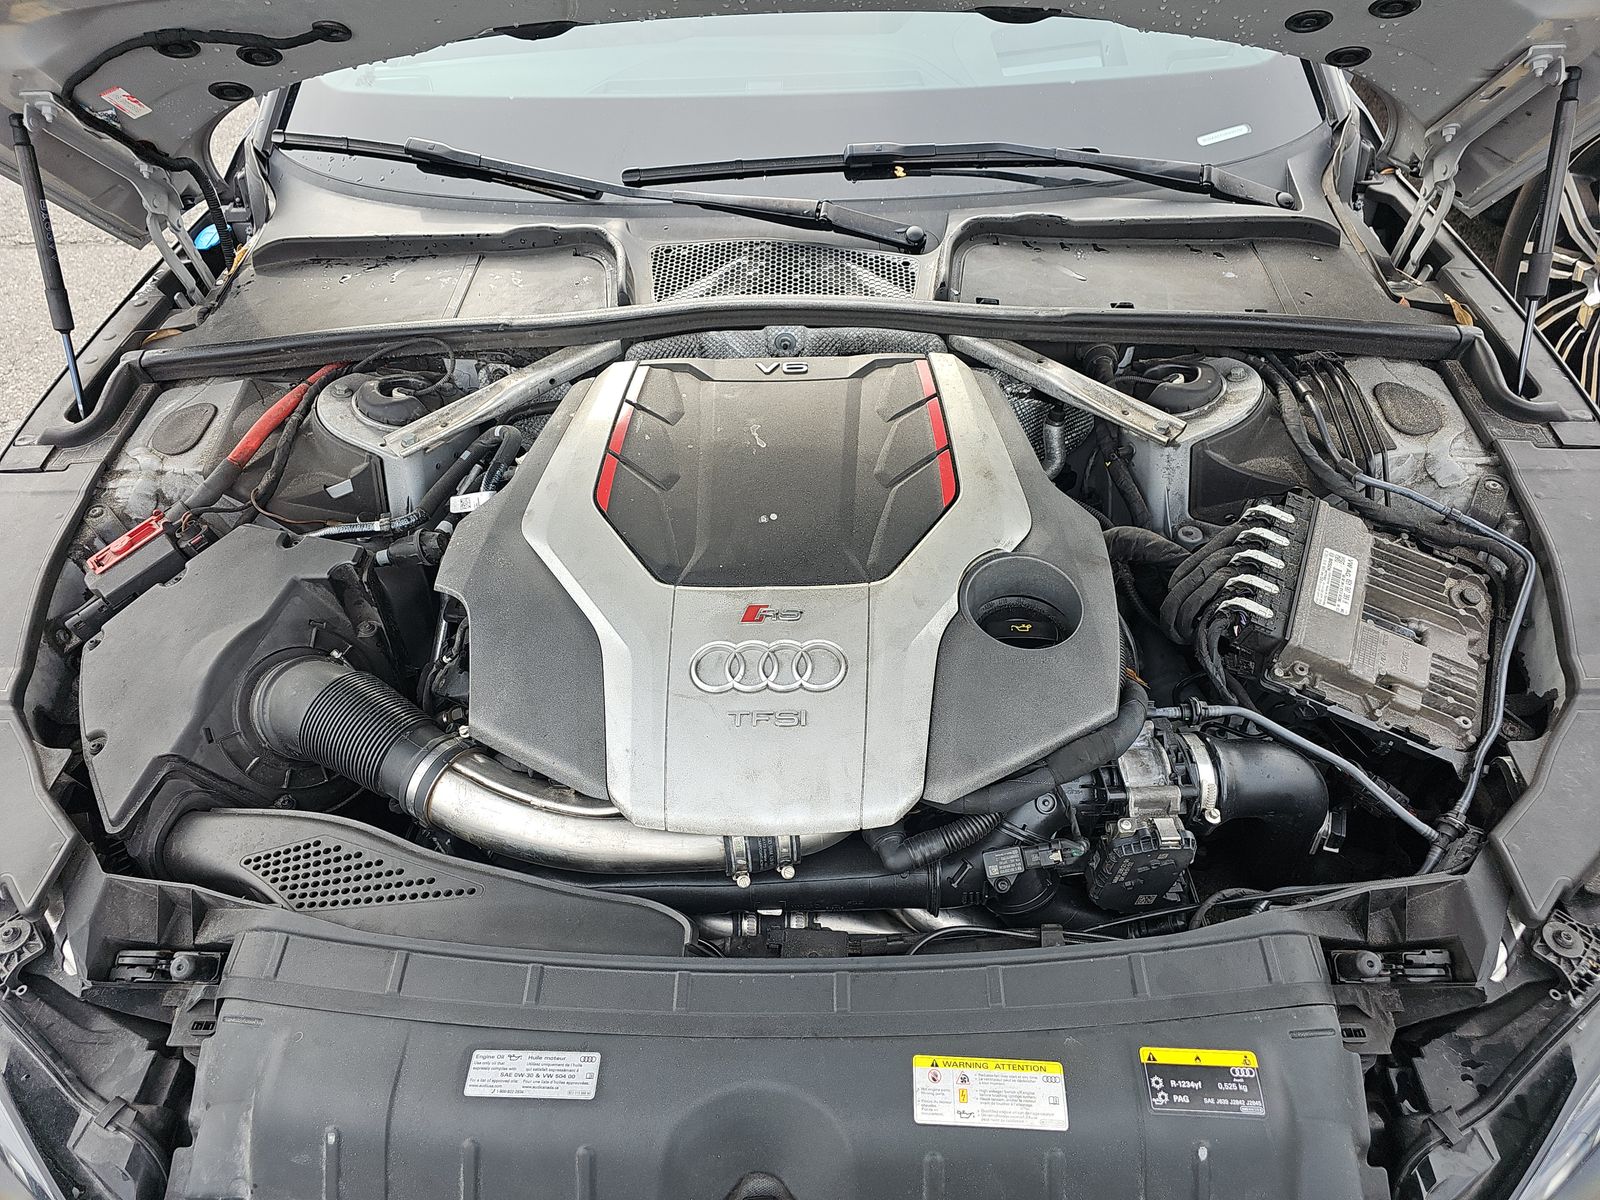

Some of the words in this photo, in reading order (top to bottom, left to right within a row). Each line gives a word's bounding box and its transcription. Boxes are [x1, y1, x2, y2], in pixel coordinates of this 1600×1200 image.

[754, 362, 808, 375] V6
[754, 606, 804, 623] RS
[728, 710, 808, 728] TFSI
[942, 1060, 989, 1070] WARNING
[994, 1063, 1047, 1072] ATTENTION
[1170, 1080, 1202, 1090] R-1234yf
[1218, 1082, 1237, 1091] 0,525
[1238, 1084, 1248, 1092] kg
[1173, 1094, 1190, 1103] PAG
